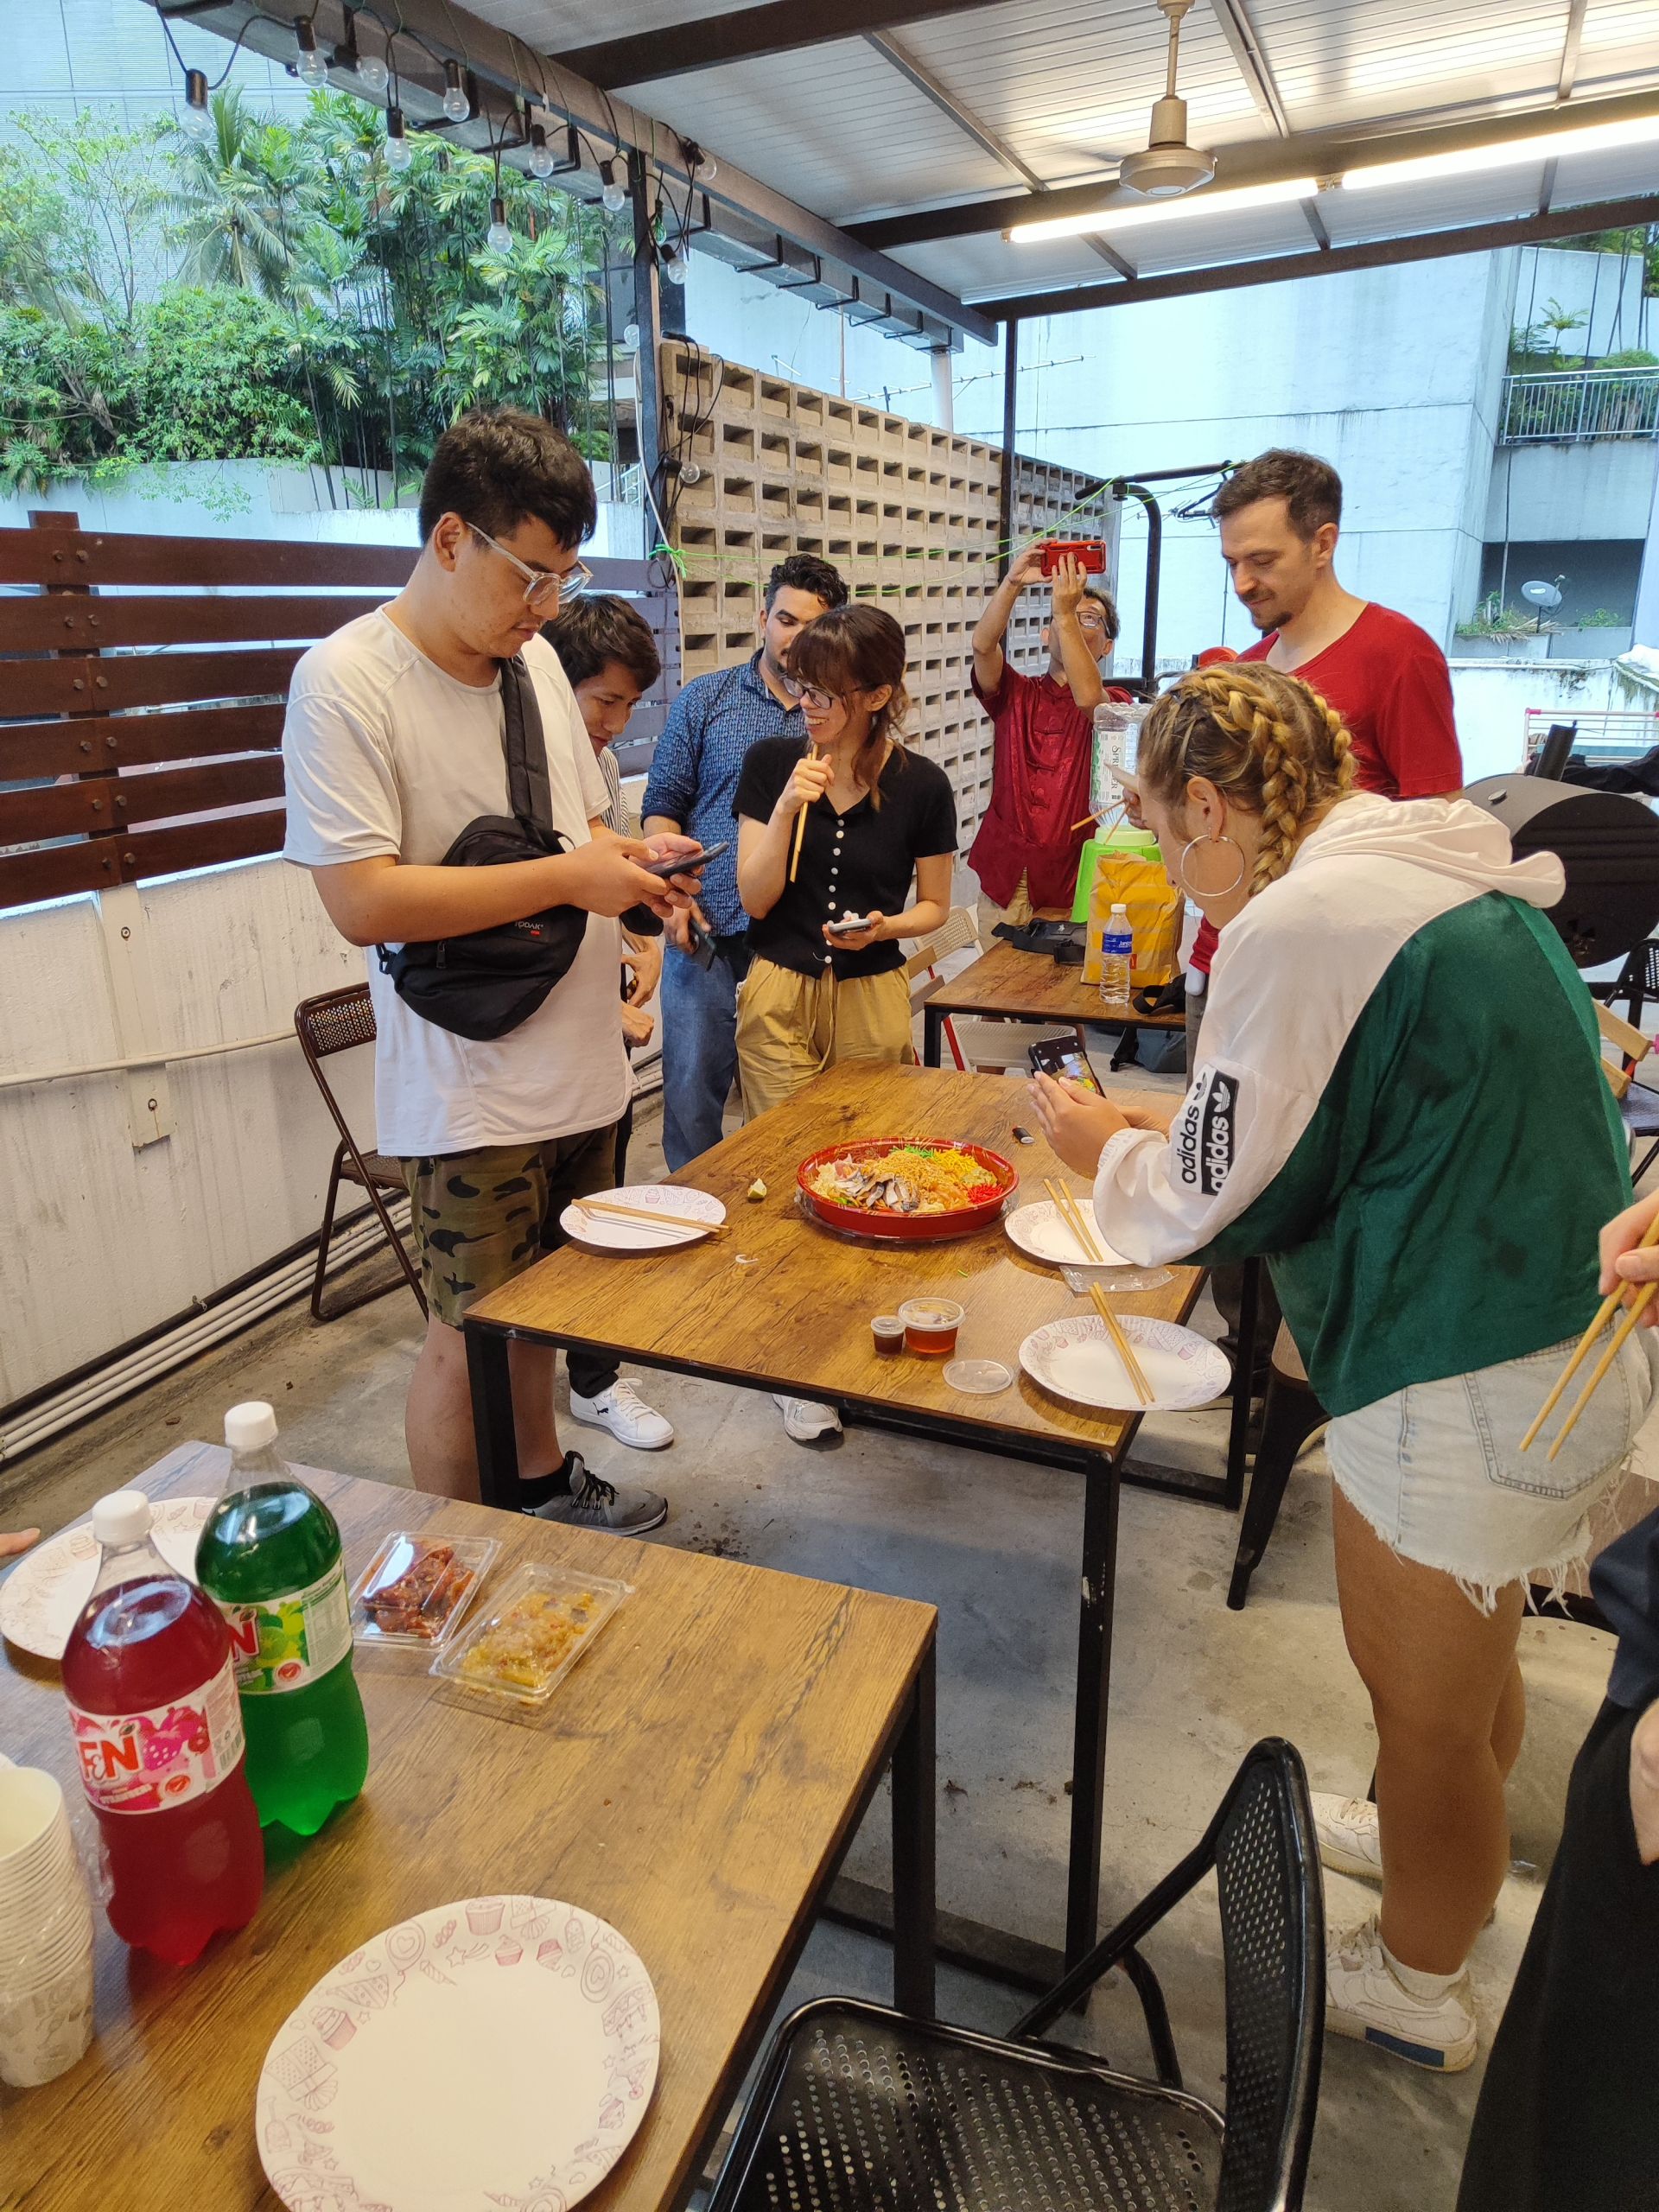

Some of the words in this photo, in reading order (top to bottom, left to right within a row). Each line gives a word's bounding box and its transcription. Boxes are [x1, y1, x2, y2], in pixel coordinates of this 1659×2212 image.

[1111, 745, 1122, 789] SPRIER
[1177, 1104, 1200, 1184] adidas
[1205, 1116, 1230, 1192] adidas
